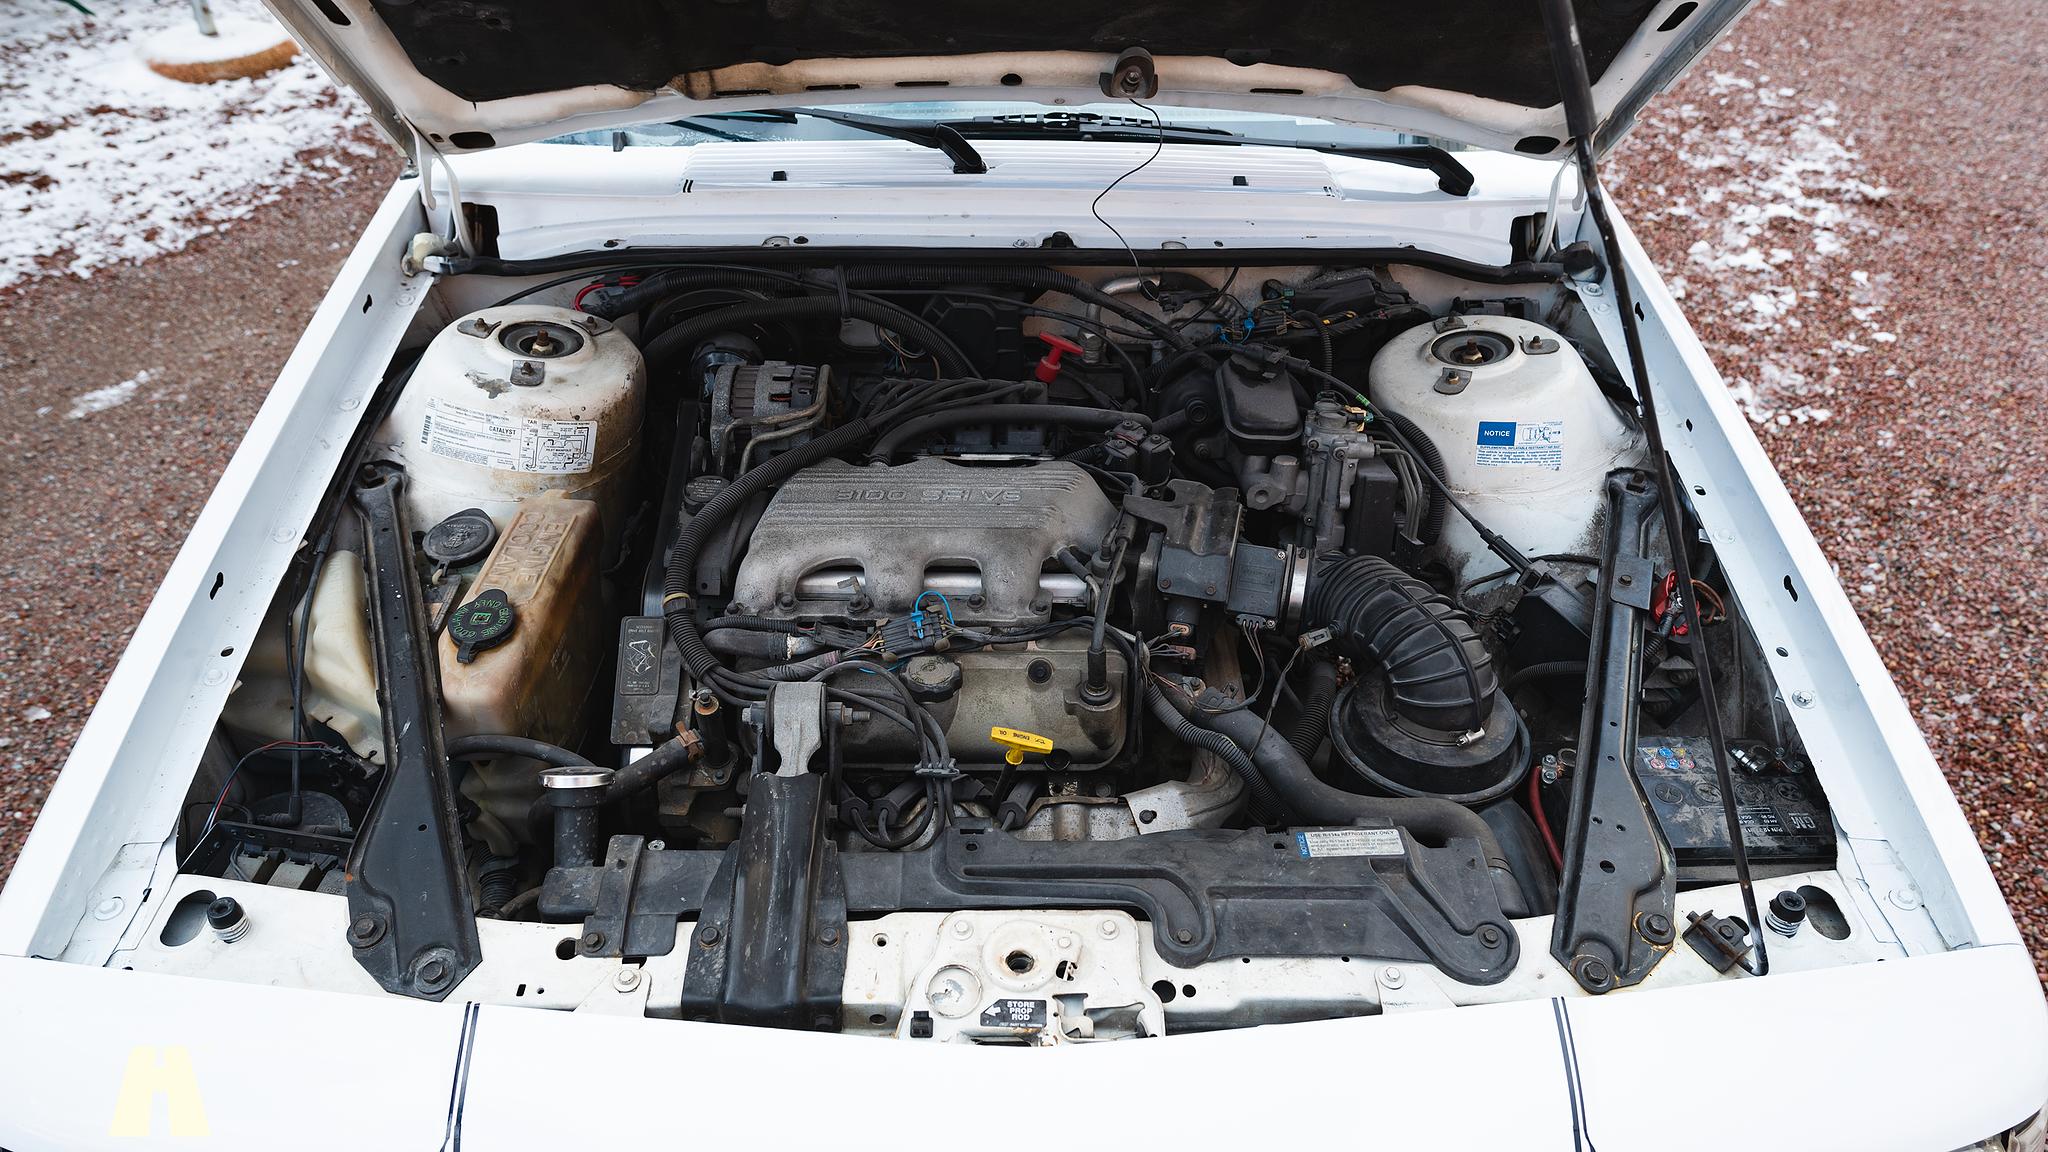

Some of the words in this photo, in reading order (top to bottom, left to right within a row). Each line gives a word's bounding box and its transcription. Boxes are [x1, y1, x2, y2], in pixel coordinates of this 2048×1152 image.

[488, 425, 517, 436] CATALYST
[836, 489, 907, 501] 3100
[921, 488, 973, 502] SFI
[981, 489, 1023, 502] V6
[483, 511, 545, 589] COOLANT
[518, 522, 568, 585] ENGINE
[474, 599, 503, 610] ONLY
[452, 606, 477, 639] COOLANT
[481, 607, 509, 638] ENGINE
[1792, 816, 1816, 829] GM
